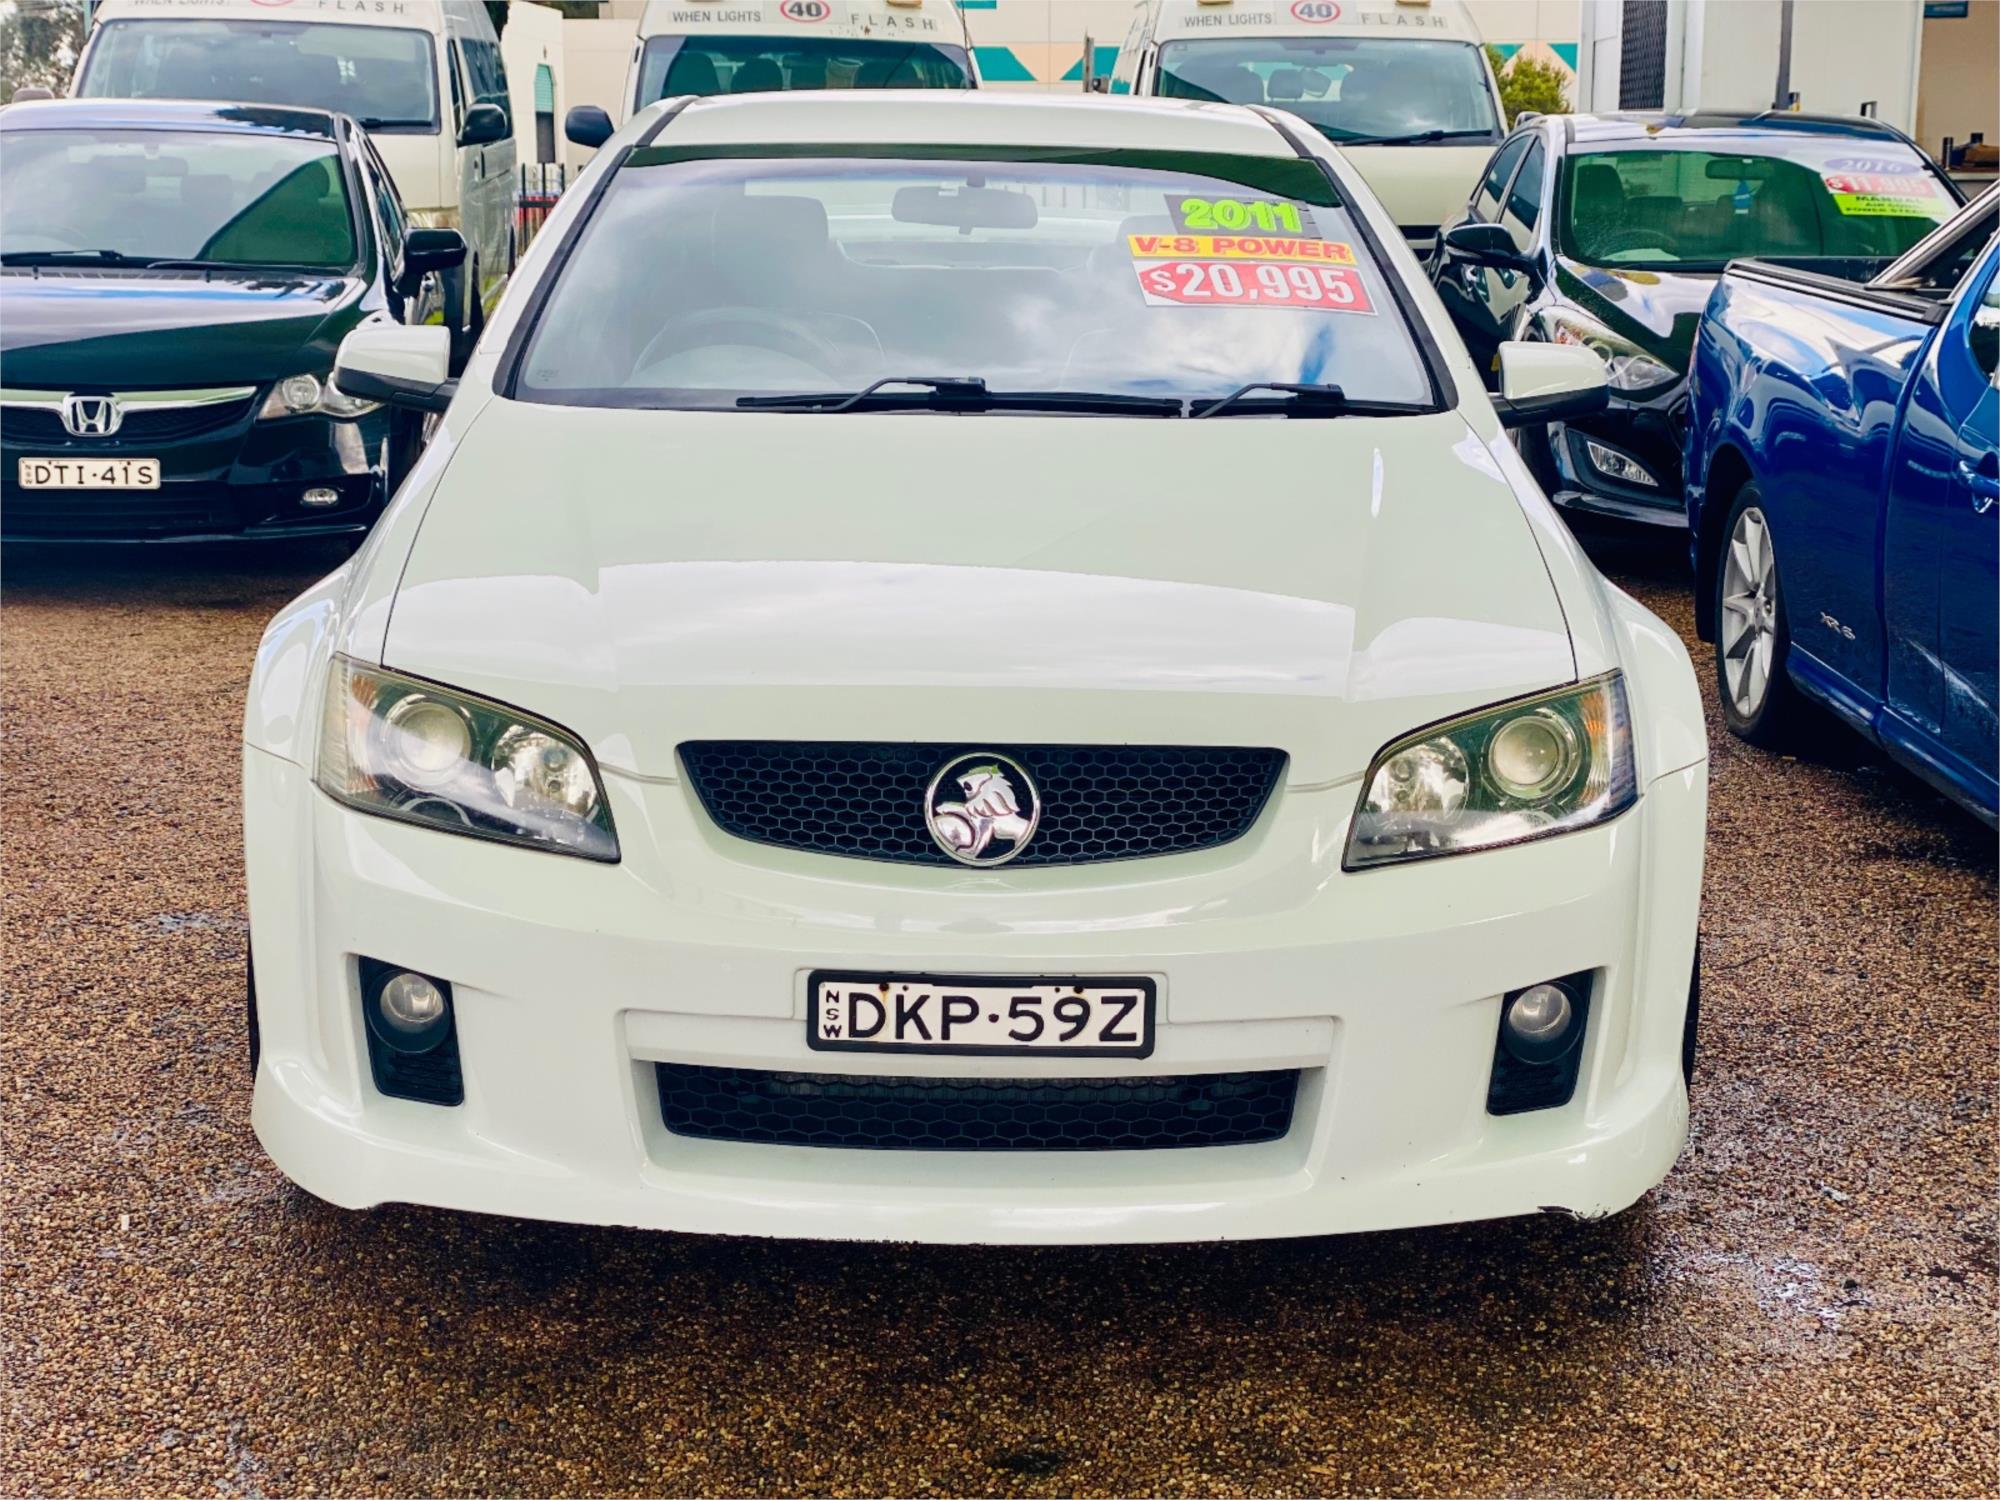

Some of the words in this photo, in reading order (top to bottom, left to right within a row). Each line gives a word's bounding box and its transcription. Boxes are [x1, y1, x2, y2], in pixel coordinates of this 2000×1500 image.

[318, 0, 404, 14] FLASH
[787, 0, 823, 17] 40
[1298, 1, 1333, 18] 40
[672, 11, 711, 23] WHEN
[716, 11, 761, 23] LIGHTS
[850, 14, 934, 30] FLASH
[1184, 15, 1222, 28] WHEN
[1228, 13, 1272, 26] LIGHTS
[1361, 14, 1444, 27] FLASH
[1842, 159, 1902, 173] 2016
[1180, 198, 1303, 233] 2011
[1135, 236, 1199, 256] V-8
[1211, 237, 1351, 261] POWER
[1150, 263, 1355, 304] $20,995
[823, 990, 843, 1039] NSW
